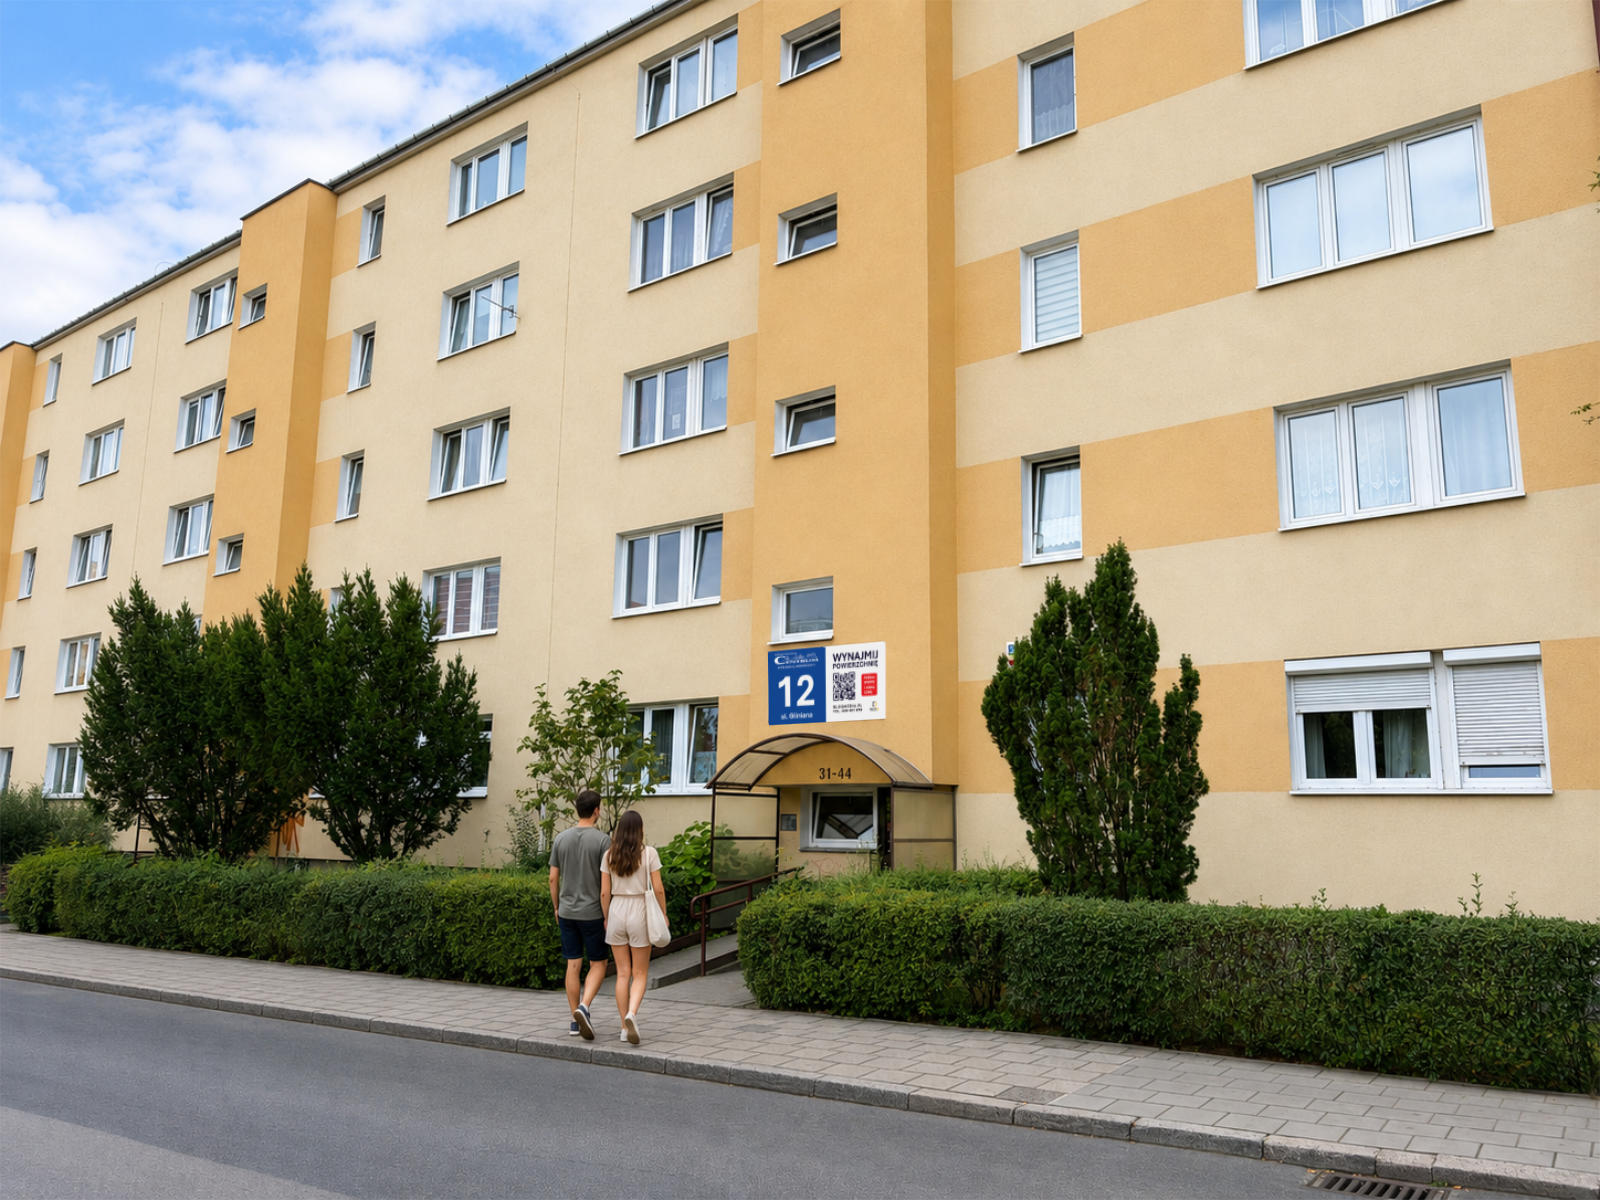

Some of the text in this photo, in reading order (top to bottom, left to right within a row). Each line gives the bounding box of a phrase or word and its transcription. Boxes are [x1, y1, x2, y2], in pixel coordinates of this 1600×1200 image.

[832, 649, 879, 662] WYNAJMIJ
[778, 674, 815, 708] 12
[819, 767, 852, 780] 31-44
